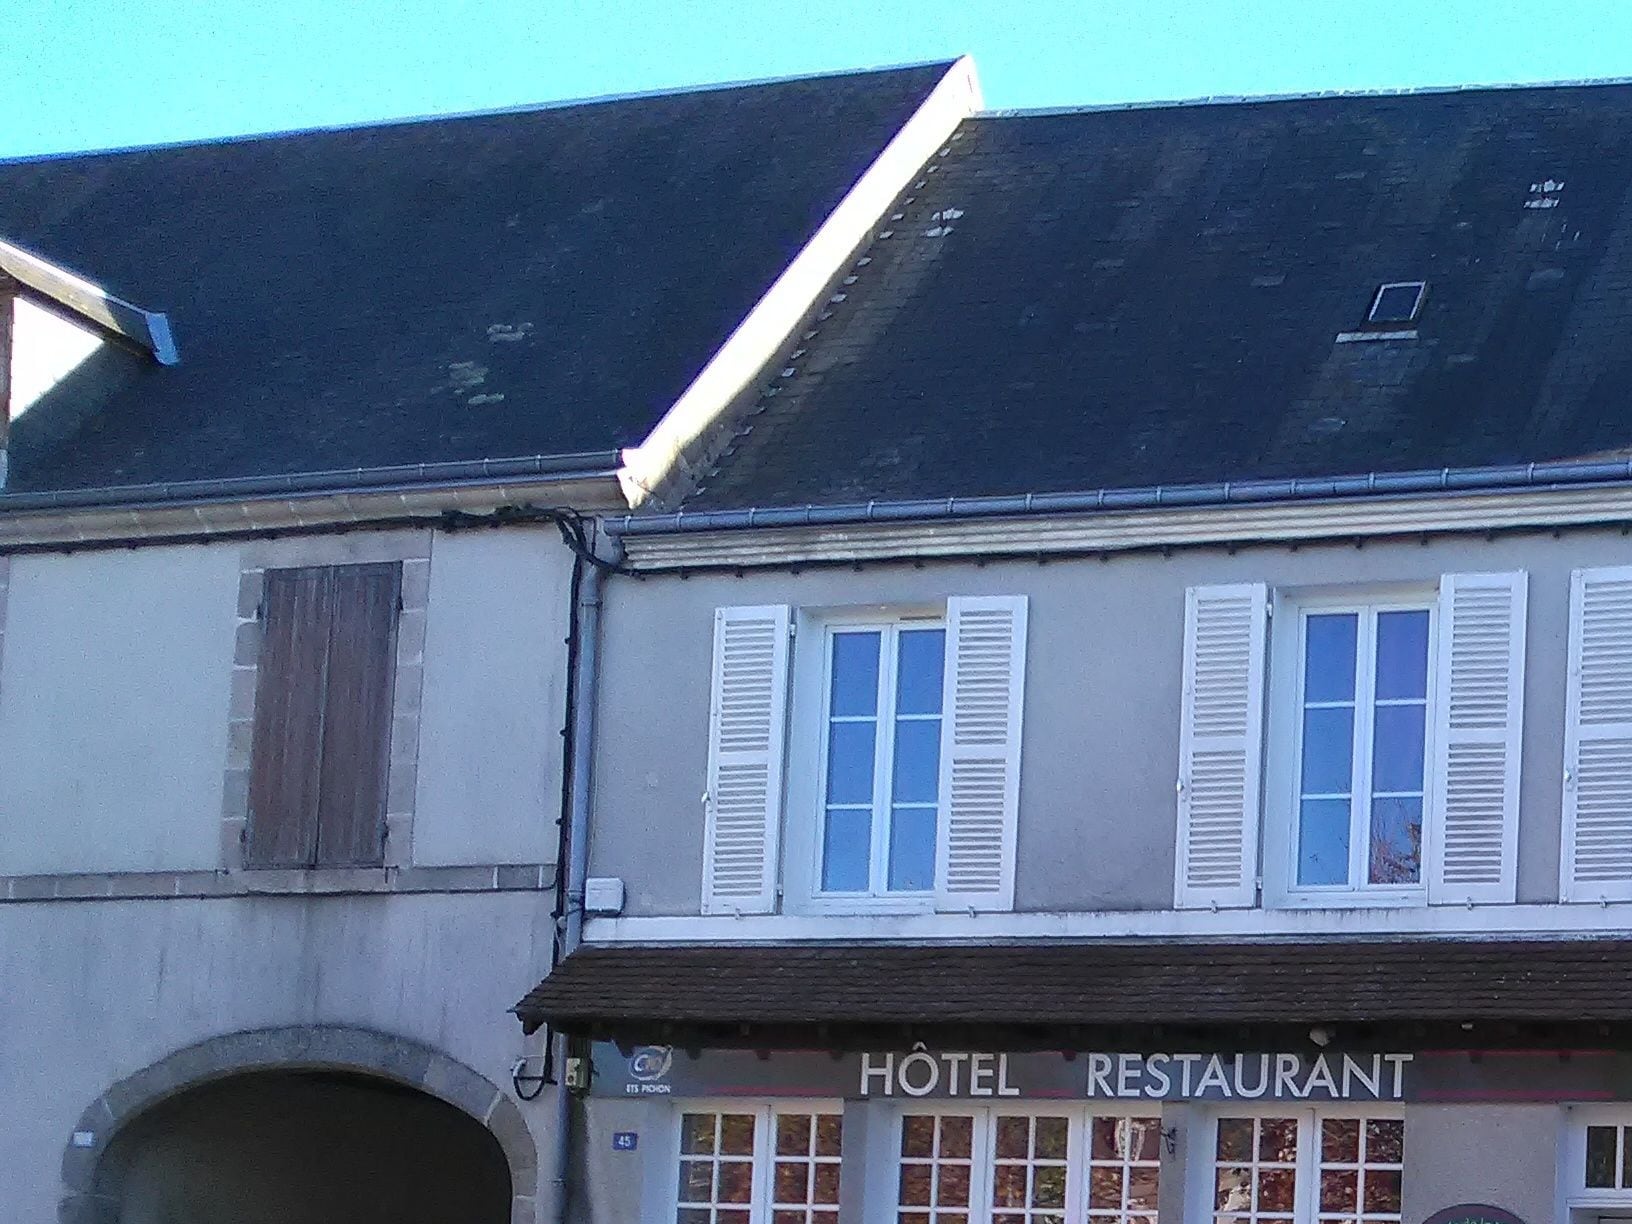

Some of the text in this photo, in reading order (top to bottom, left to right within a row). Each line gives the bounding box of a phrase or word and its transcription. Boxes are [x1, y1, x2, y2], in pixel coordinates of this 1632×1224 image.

[860, 1042, 1414, 1098] HÔTEL RESTAURANT
[618, 1135, 631, 1147] 45
